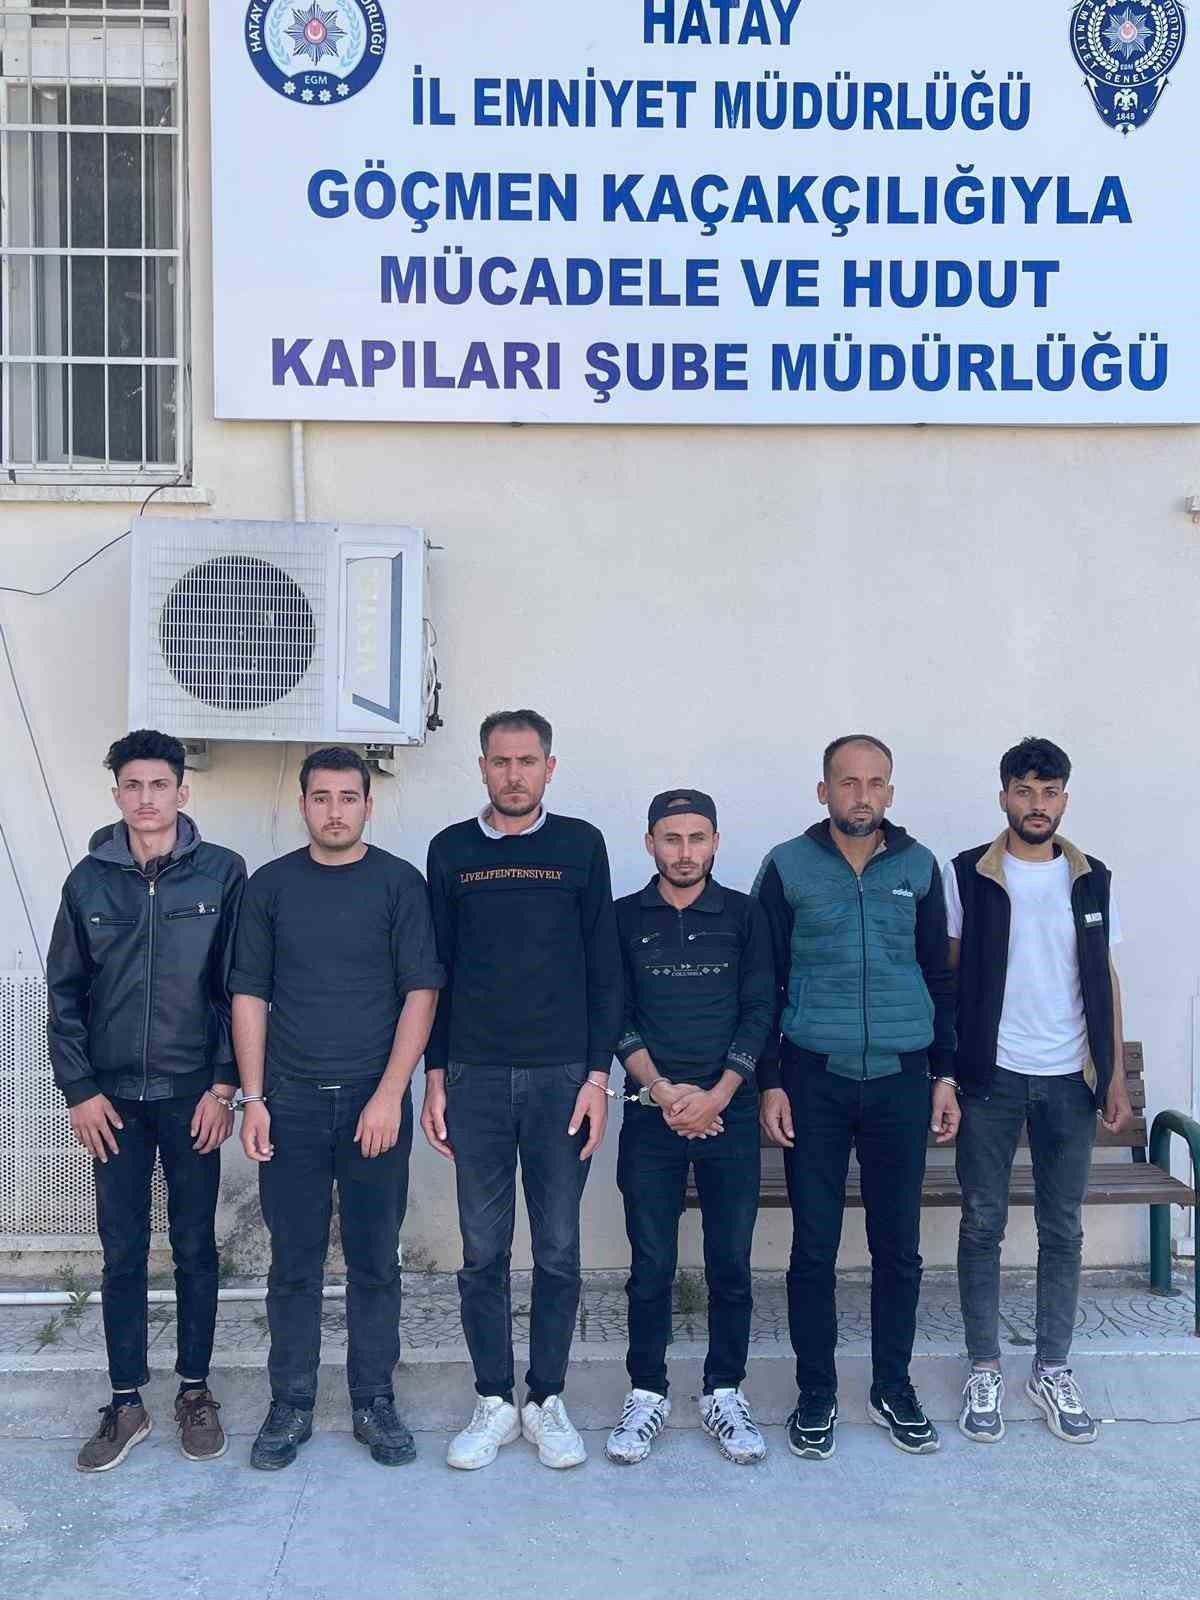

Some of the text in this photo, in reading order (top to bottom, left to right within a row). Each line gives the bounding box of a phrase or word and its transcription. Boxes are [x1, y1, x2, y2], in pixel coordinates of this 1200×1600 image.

[249, 2, 263, 52] HATAY
[644, 0, 802, 46] HATAY
[304, 76, 328, 85] EGM
[413, 65, 1030, 131] İL EMNİYET MÜDÜRLÜĞÜ
[1105, 72, 1148, 83] GENEL
[1115, 112, 1136, 121] 1845
[307, 159, 1132, 237] GÖÇMEN KAÇAKÇILIĞIYLA
[381, 245, 1060, 309] MÜCADELE VE HUDUT
[272, 332, 1168, 404] KAPILARI ŞUBE MÜDÜRLÜĞÜ
